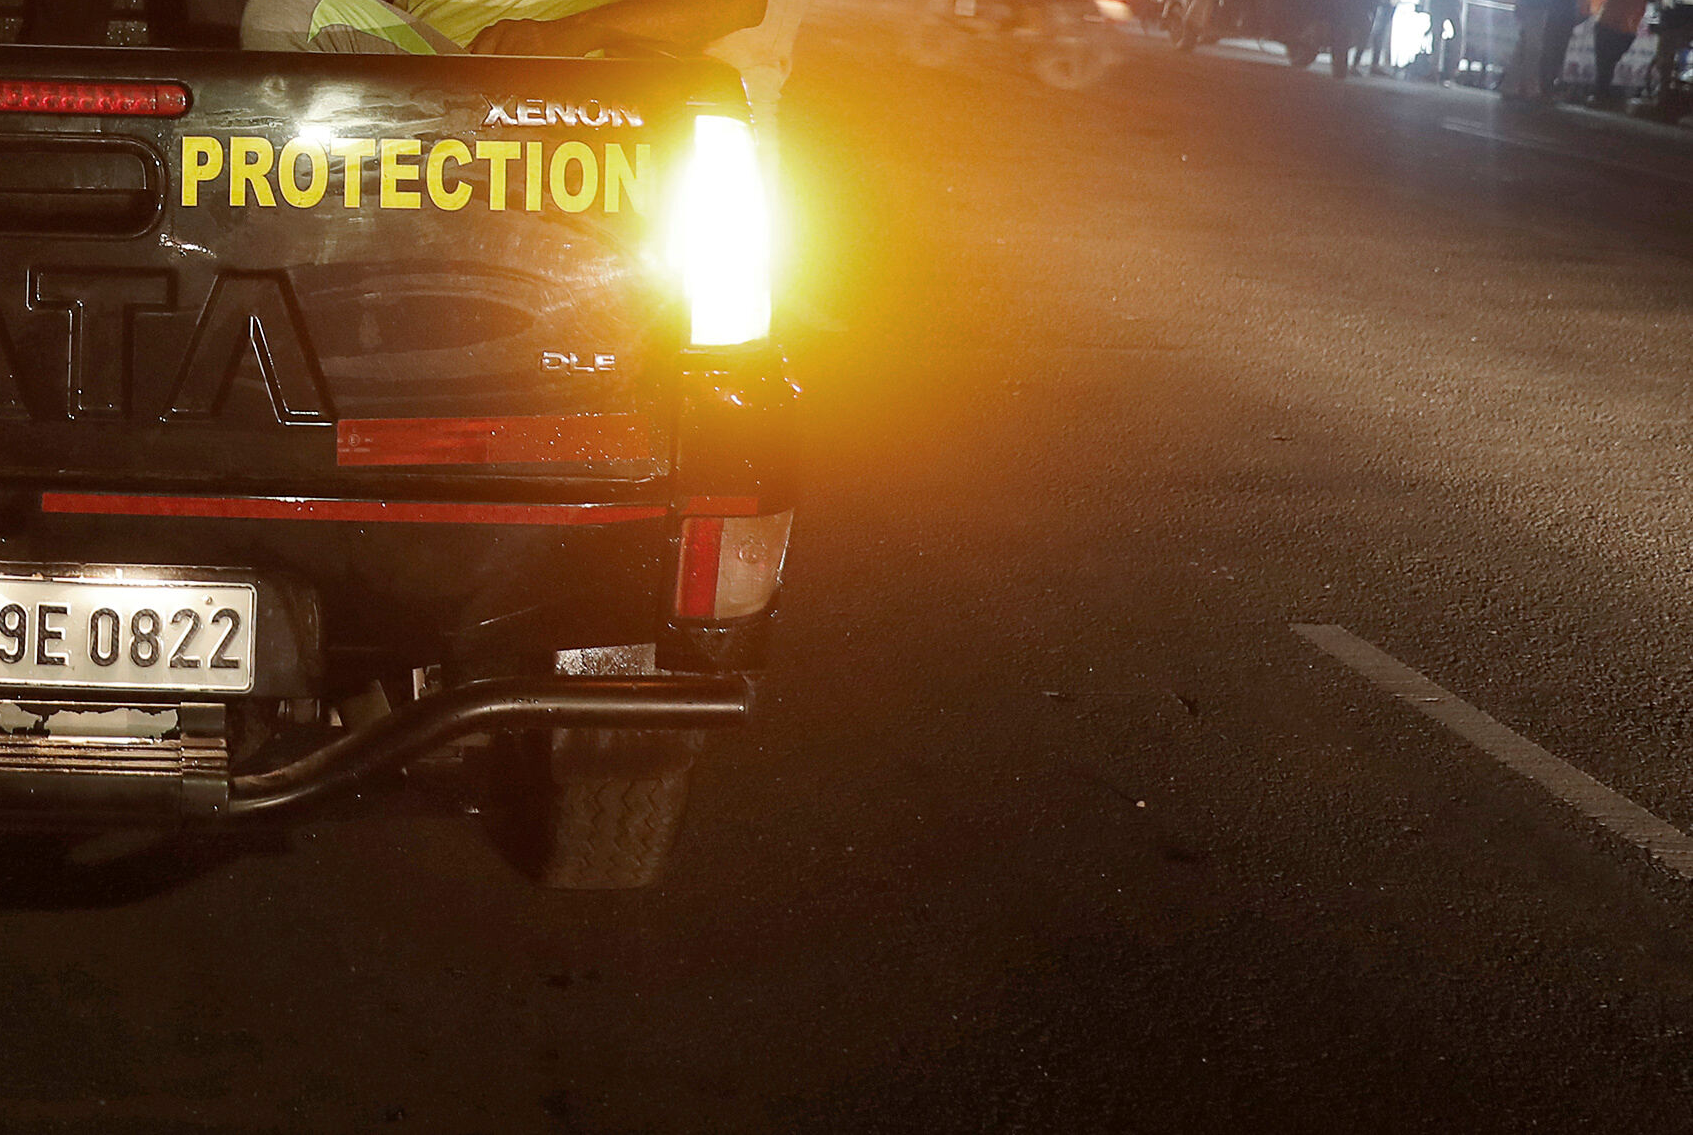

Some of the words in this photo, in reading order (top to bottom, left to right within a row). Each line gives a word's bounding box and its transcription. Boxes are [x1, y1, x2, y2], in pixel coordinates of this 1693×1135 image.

[480, 94, 644, 128] XENON
[180, 135, 651, 214] PROTECTION
[89, 607, 244, 670] 0822
